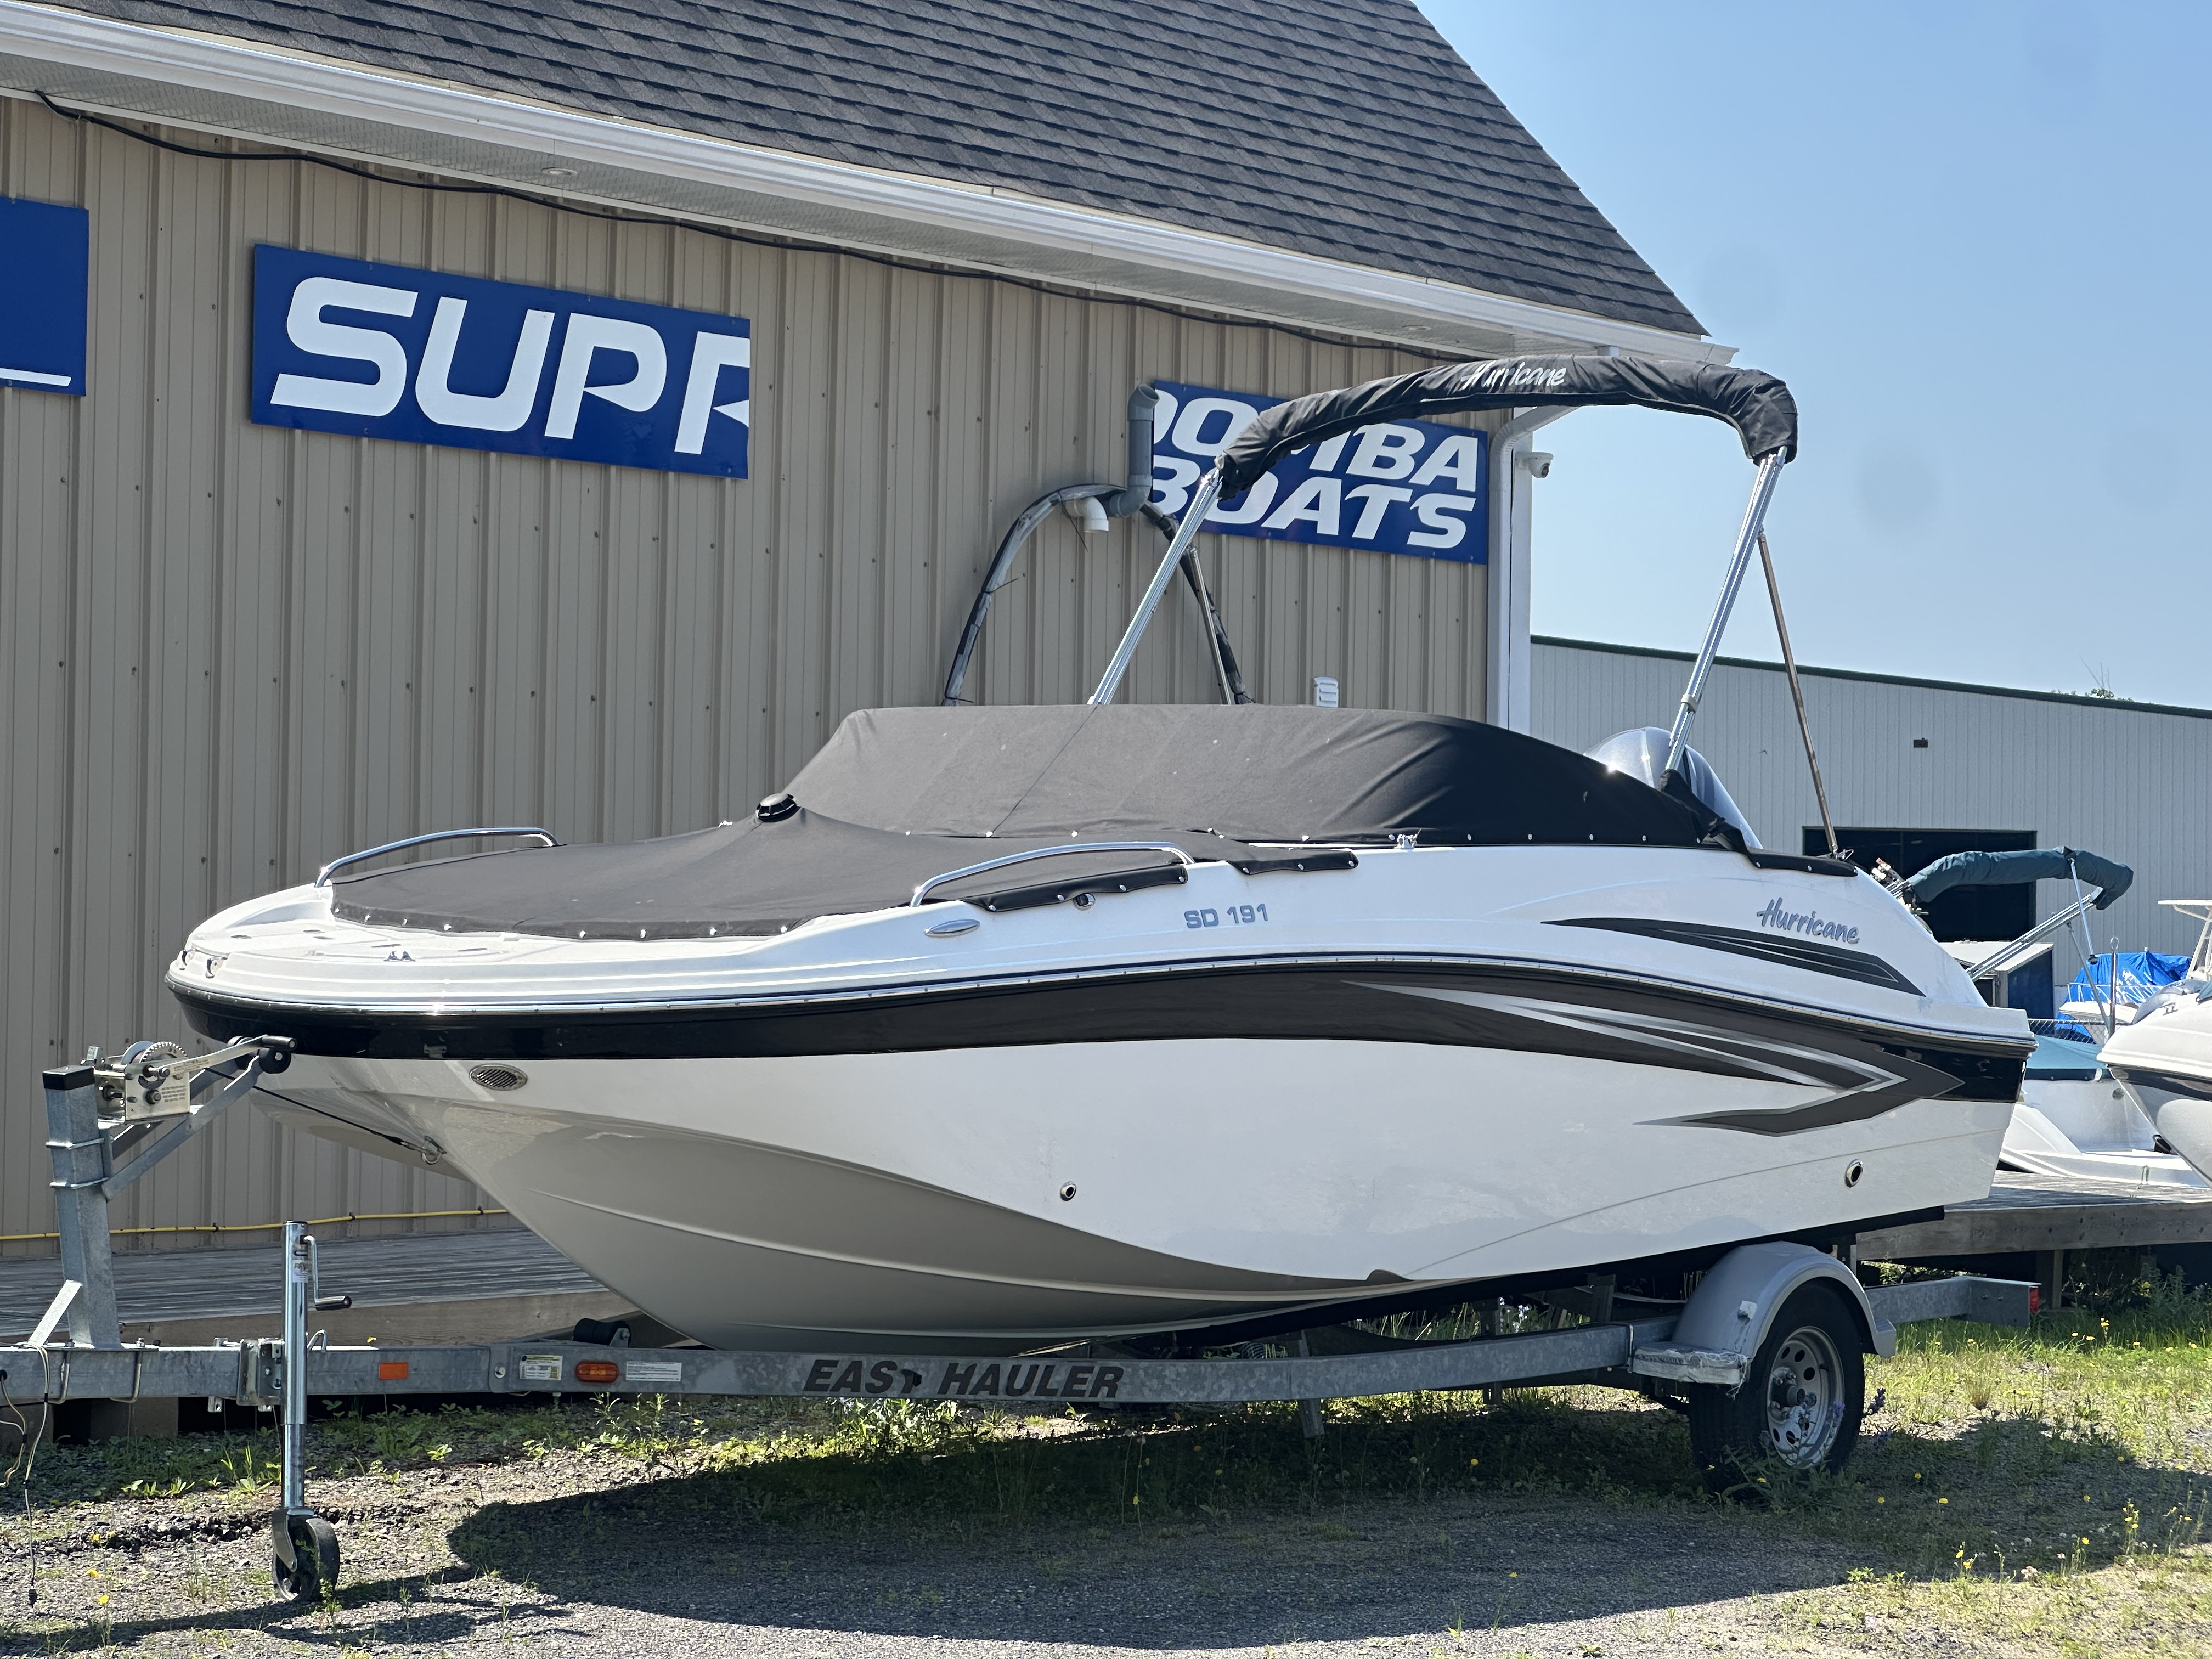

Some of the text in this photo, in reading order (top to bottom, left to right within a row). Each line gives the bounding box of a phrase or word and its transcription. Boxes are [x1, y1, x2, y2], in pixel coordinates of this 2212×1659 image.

[1461, 360, 1566, 390] Hurricane
[1153, 389, 1478, 492] OBA
[1184, 904, 1268, 928] SD 191
[1757, 896, 1860, 945] Hurricane
[937, 1362, 1124, 1398] HAULER
